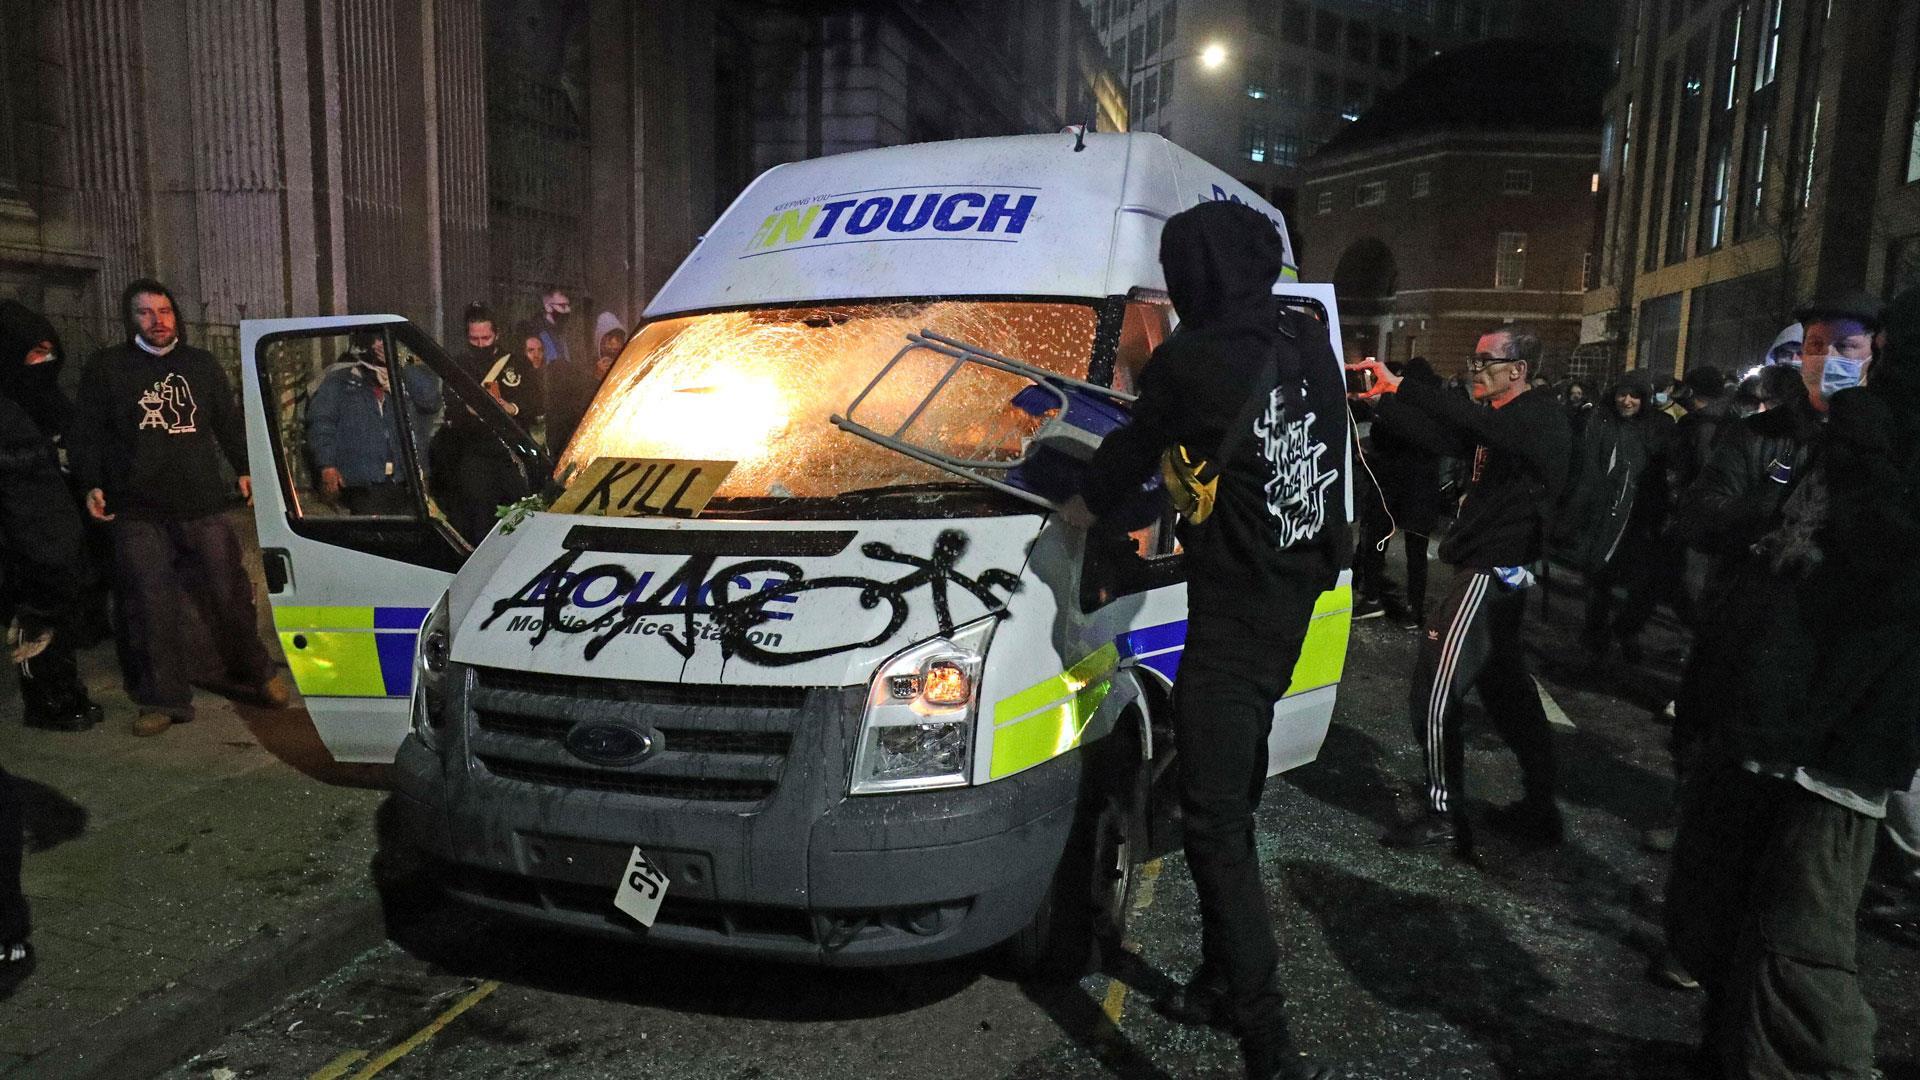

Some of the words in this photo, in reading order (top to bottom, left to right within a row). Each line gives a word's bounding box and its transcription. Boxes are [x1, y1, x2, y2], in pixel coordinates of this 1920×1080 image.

[773, 197, 811, 211] KEEPING
[812, 193, 831, 203] YOU
[574, 461, 702, 516] KILL
[506, 615, 587, 632] Moile
[682, 620, 783, 647] Staon
